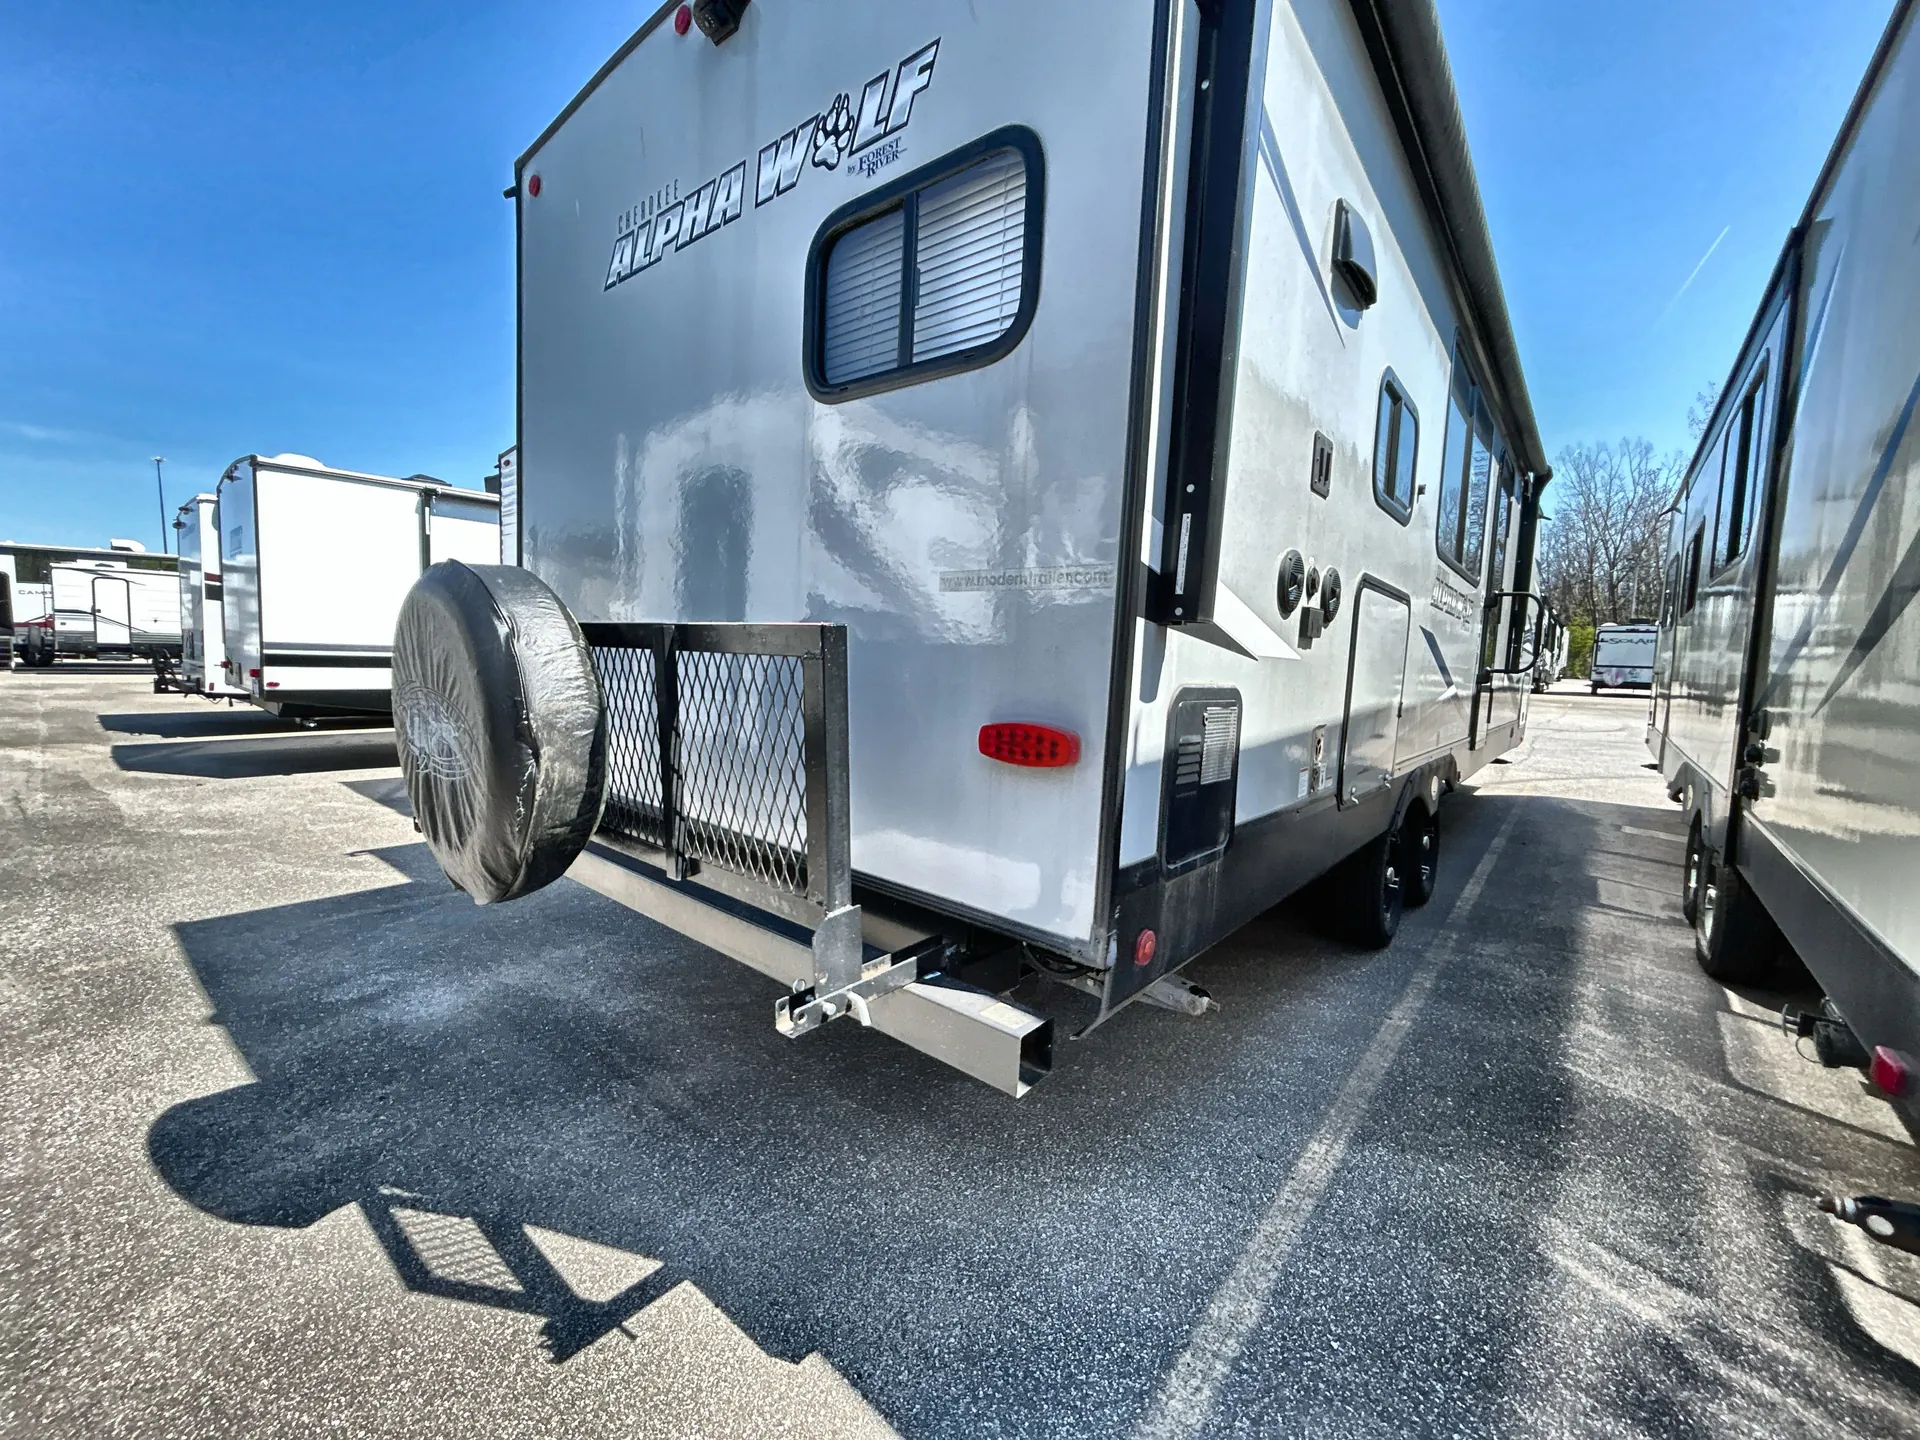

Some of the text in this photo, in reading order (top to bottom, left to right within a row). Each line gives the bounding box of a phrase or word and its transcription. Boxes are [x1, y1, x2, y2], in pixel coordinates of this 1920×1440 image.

[858, 136, 902, 171] FOREST
[866, 150, 900, 178] RIVER
[604, 160, 747, 292] ALPHA
[618, 178, 678, 235] CHEROKEE
